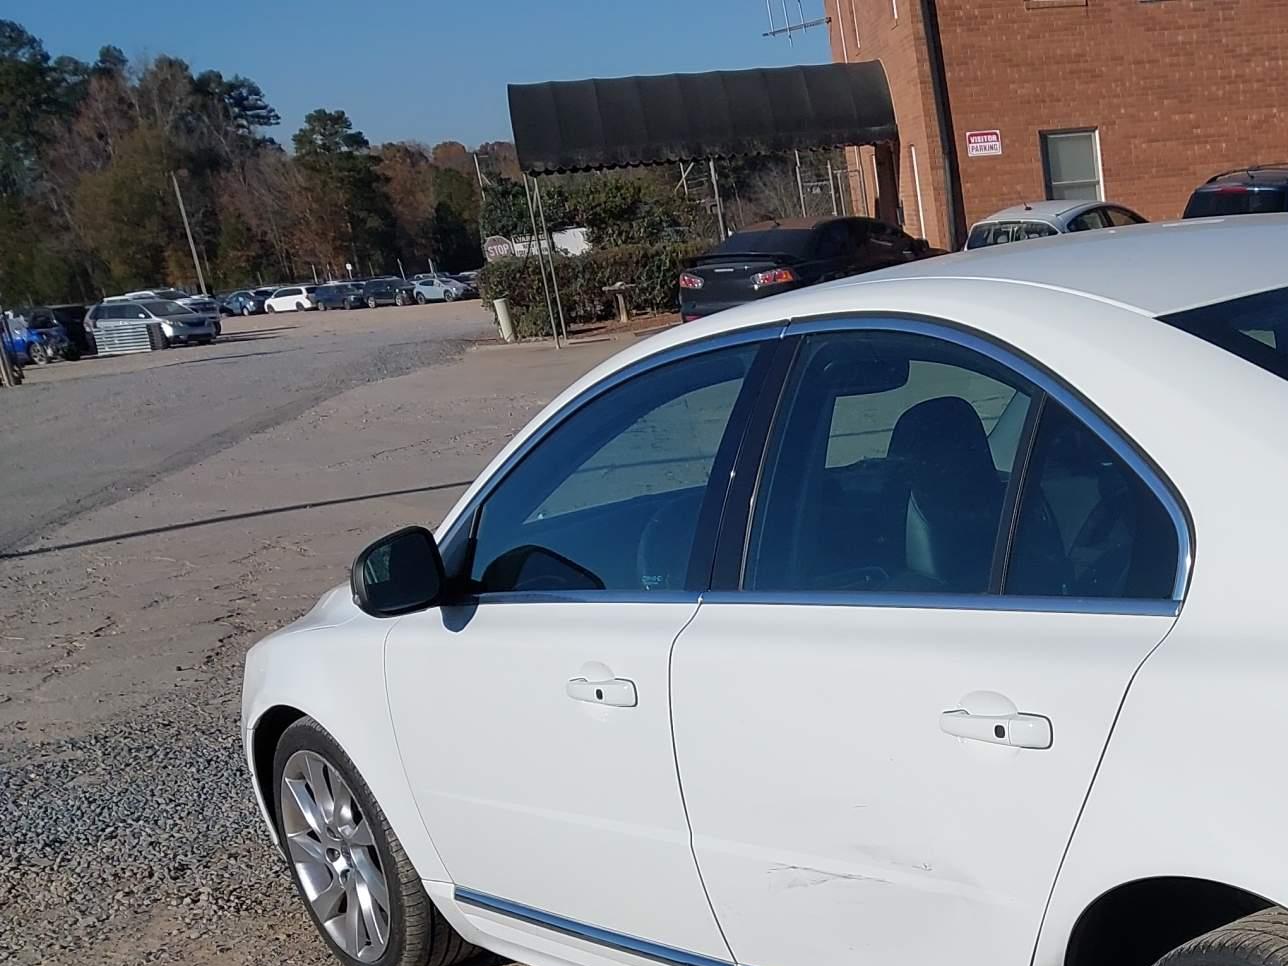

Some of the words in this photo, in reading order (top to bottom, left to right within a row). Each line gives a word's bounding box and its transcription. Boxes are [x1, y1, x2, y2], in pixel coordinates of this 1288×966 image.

[970, 134, 998, 143] VISITOR
[971, 143, 999, 152] PARKING
[487, 243, 509, 257] STOP
